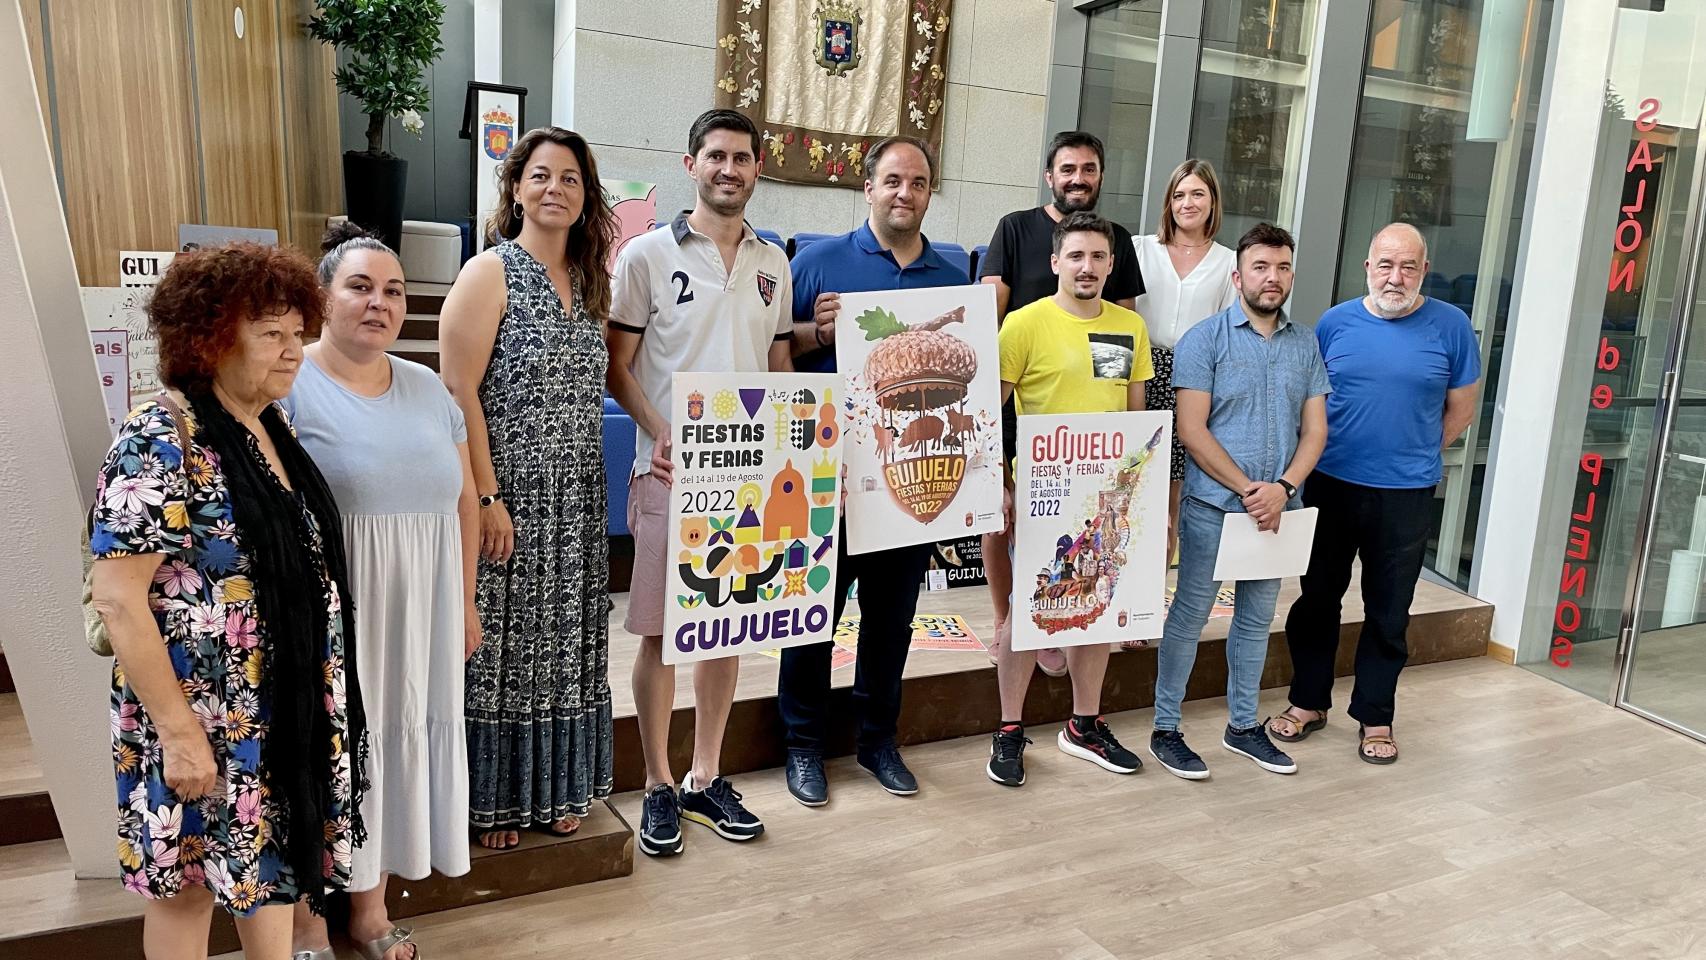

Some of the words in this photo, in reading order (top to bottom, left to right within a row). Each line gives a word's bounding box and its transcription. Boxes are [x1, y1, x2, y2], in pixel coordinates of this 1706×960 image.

[121, 257, 159, 276] GUI
[671, 270, 694, 305] 2
[681, 423, 765, 444] FIESTAS
[1032, 424, 1124, 465] GUIJUELO
[681, 451, 694, 470] Y
[699, 449, 764, 469] FERIAS
[680, 475, 694, 485] del
[695, 475, 705, 483] 14
[706, 474, 714, 483] al
[716, 474, 725, 482] 19
[726, 473, 737, 482] de
[738, 473, 764, 483] Agosto
[885, 457, 965, 490] GUIJUELO
[1031, 464, 1062, 479] FIESTAS
[1066, 466, 1071, 476] Y
[1076, 462, 1105, 475] FERIAS
[895, 483, 925, 500] FIESTAS
[925, 482, 932, 493] Y
[932, 481, 958, 492] FERIAS
[1031, 480, 1043, 489] DEL
[1046, 479, 1053, 488] 14
[1064, 478, 1071, 487] 19
[680, 489, 736, 514] 2022
[1030, 490, 1038, 499] DE
[1039, 488, 1062, 498] AGOSTO
[1063, 488, 1071, 497] DE
[911, 500, 943, 515] 2022
[1030, 499, 1061, 517] 2022
[1034, 593, 1098, 610] GUIJUELO
[675, 604, 828, 653] GUIJUELO
